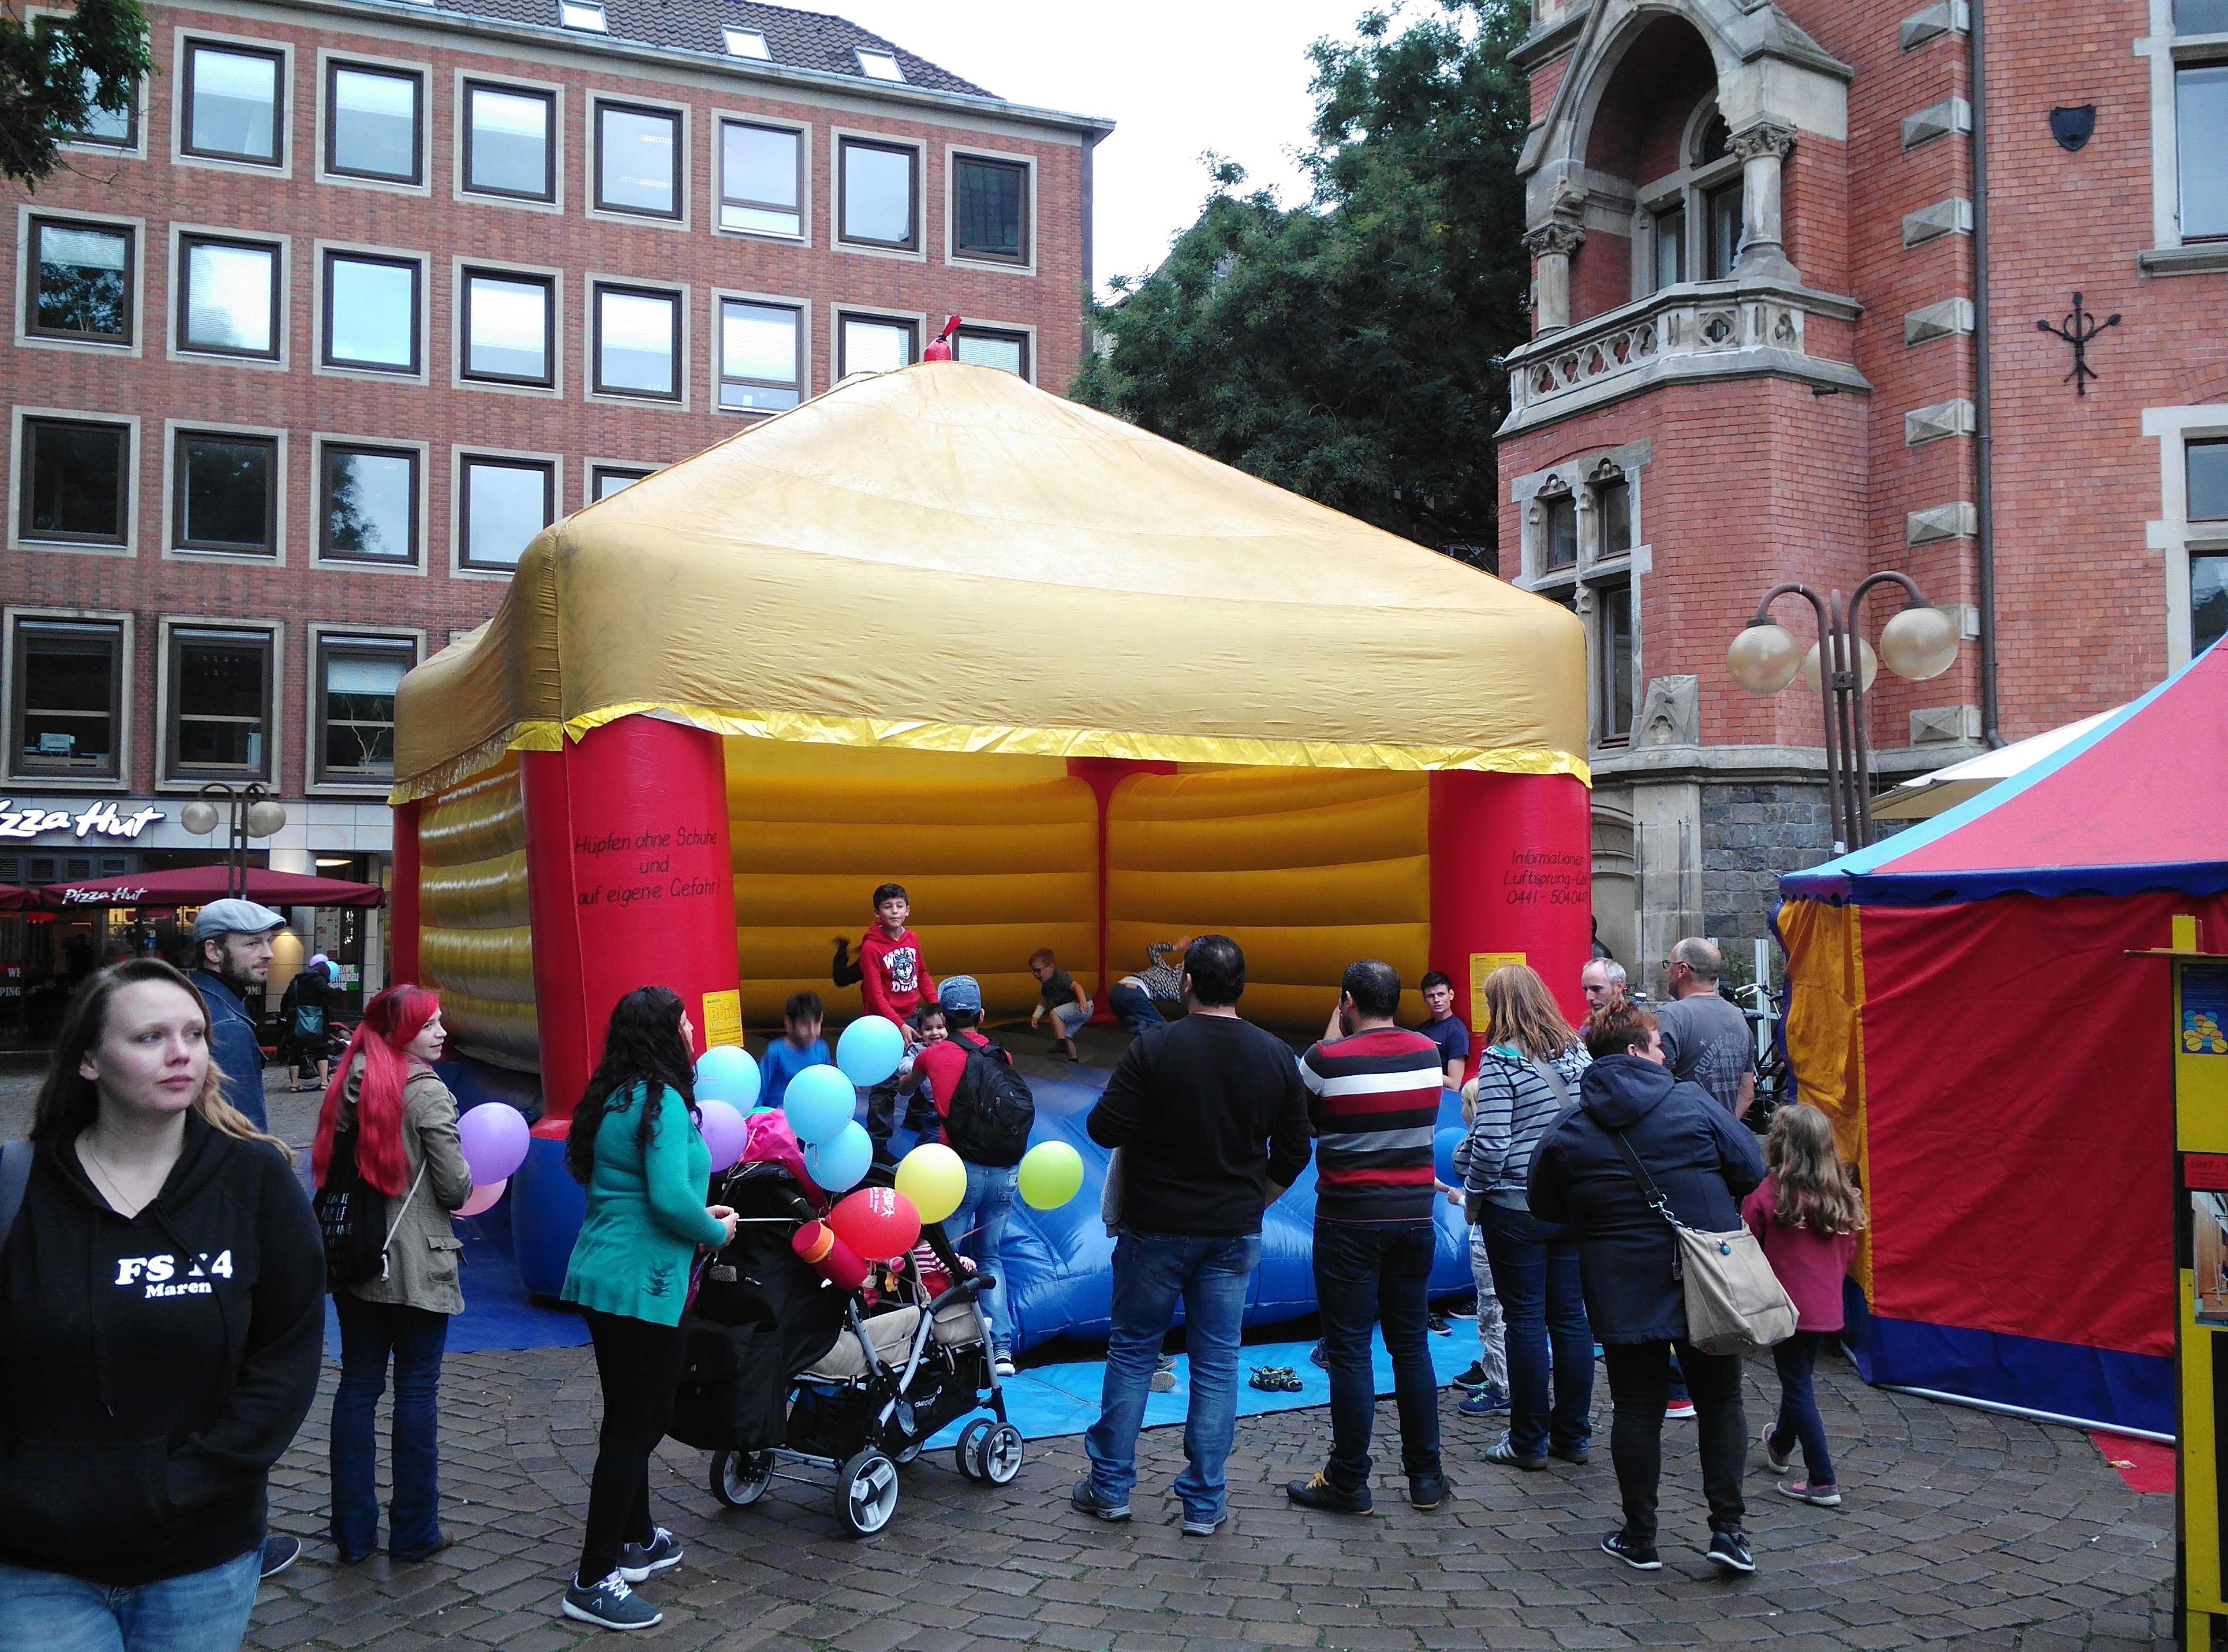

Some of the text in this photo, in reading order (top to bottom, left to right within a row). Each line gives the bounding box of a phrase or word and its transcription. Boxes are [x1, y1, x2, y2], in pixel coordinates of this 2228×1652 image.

[75, 801, 165, 837] Hut
[574, 826, 717, 858] Hüpfen ohne Schuhe
[639, 854, 670, 874] und
[62, 887, 148, 904] Pizza Hut
[578, 876, 721, 908] auf eigene Gefahr!
[114, 1254, 175, 1285] FS
[145, 1282, 212, 1298] Maren
